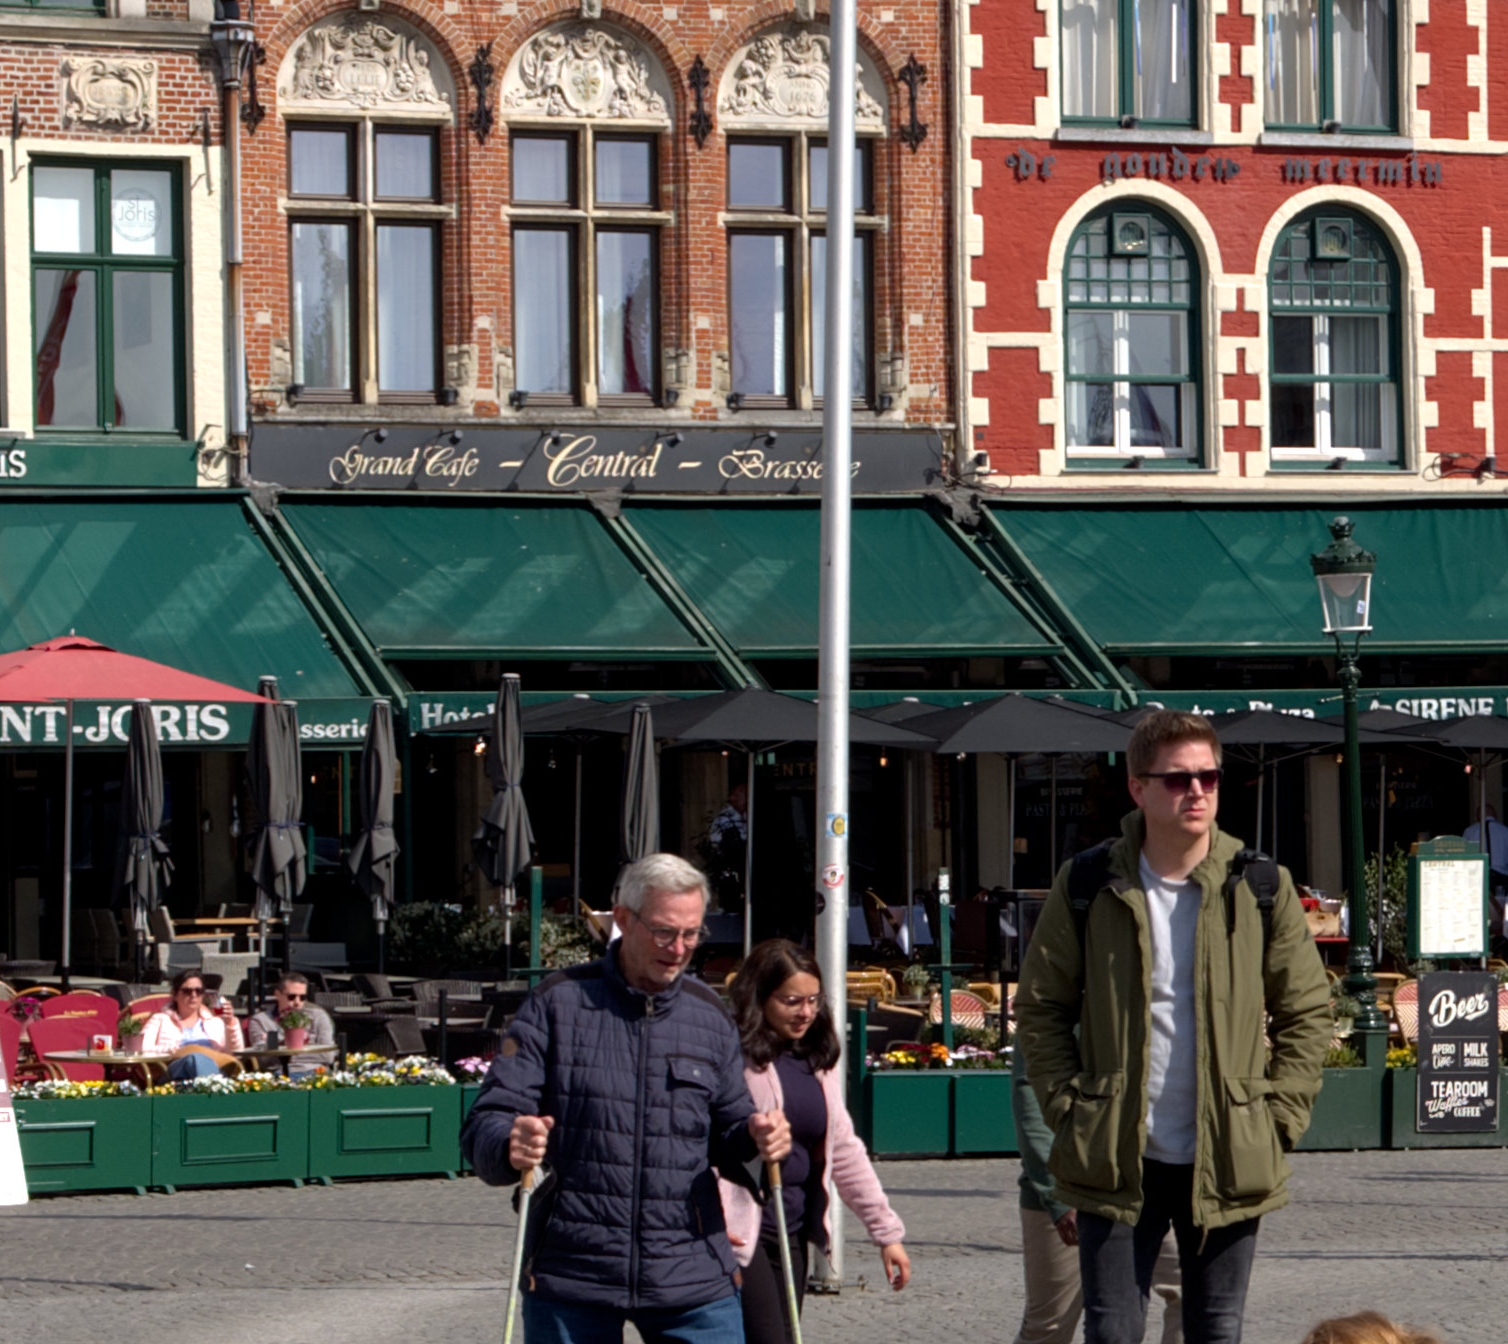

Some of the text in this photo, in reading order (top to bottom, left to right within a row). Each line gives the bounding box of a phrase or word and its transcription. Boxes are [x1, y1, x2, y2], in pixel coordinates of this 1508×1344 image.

[328, 445, 418, 487] Grand
[543, 433, 663, 487] Central
[718, 449, 861, 481] Brassee
[1395, 696, 1495, 721] SIRENE
[1428, 989, 1489, 1028] Beer
[1463, 1042, 1488, 1057] MILK
[1430, 1080, 1489, 1098] TEAROOM
